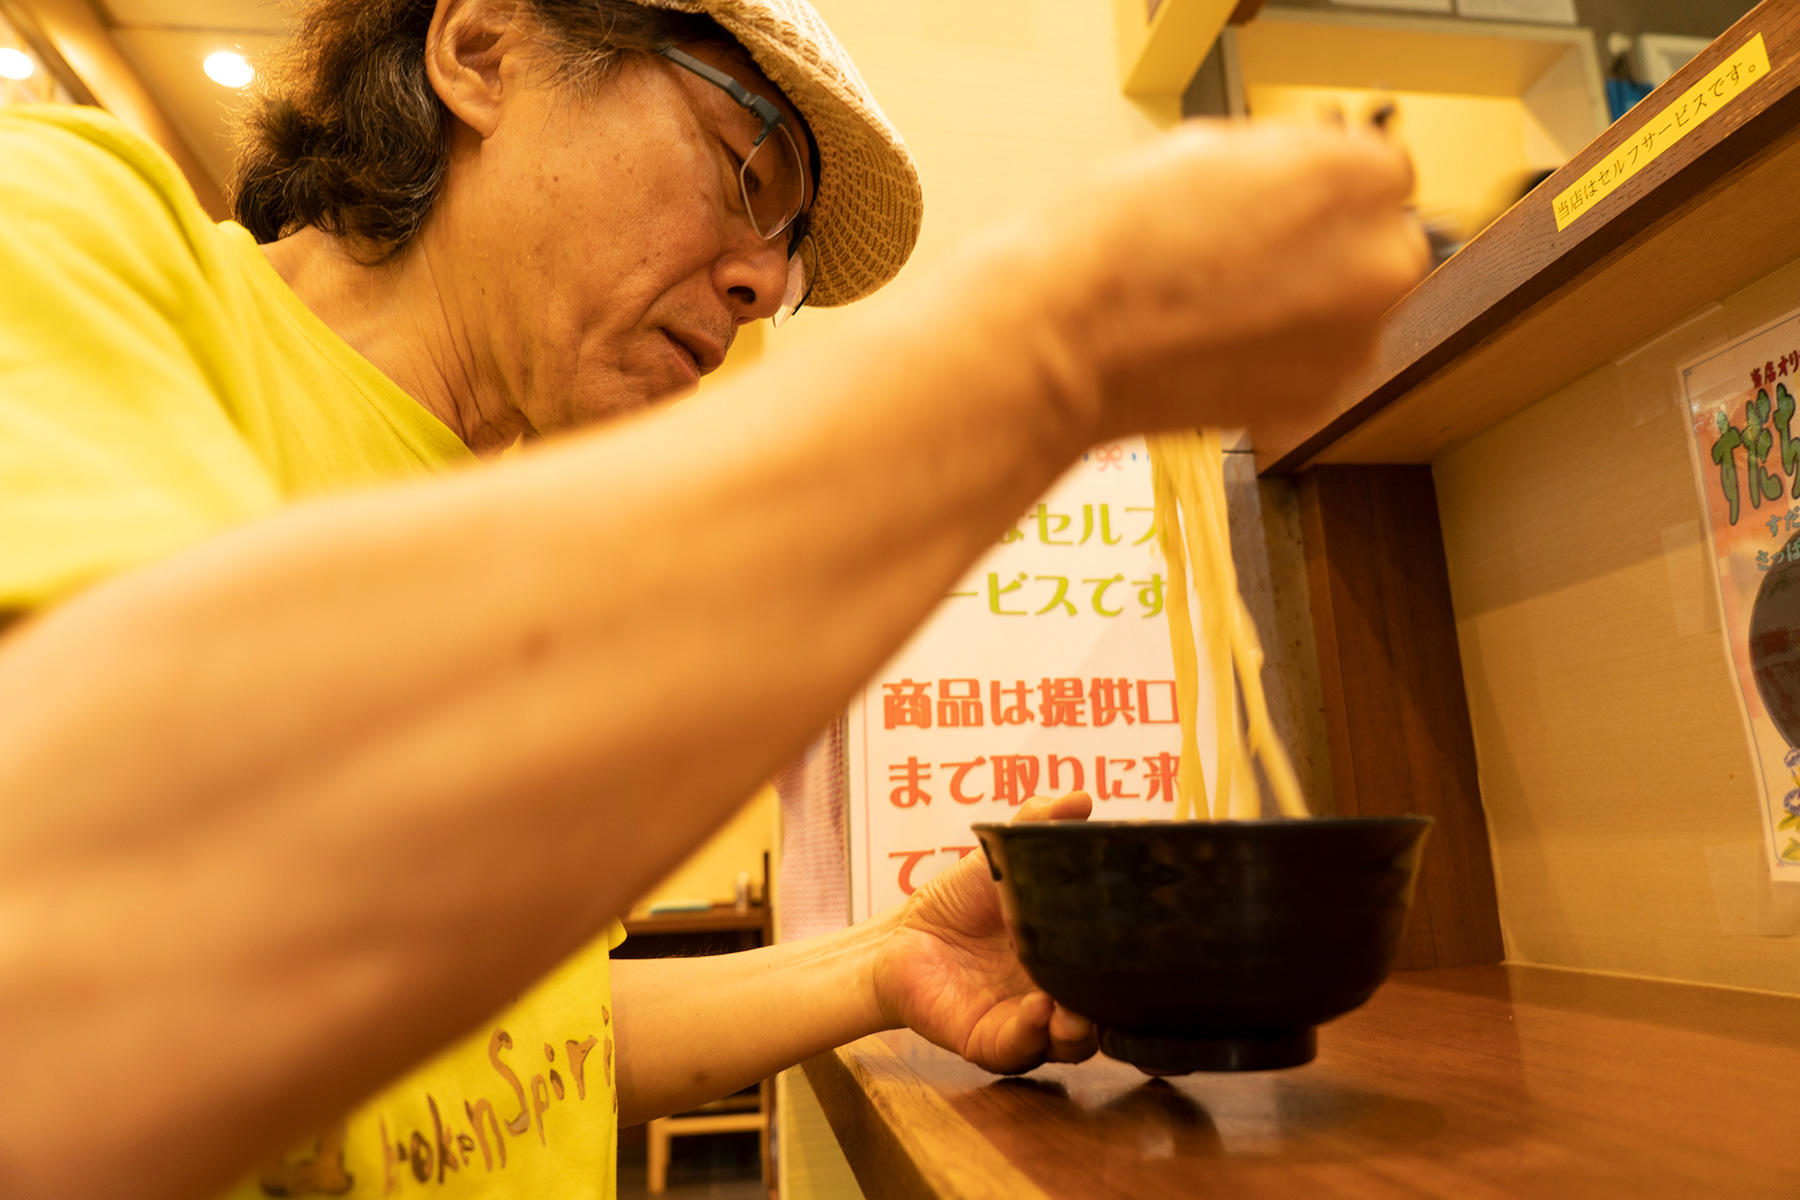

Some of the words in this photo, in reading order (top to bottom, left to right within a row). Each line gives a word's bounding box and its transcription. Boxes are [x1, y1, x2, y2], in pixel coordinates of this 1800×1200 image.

[1557, 62, 1756, 221] 当店はセルフサービスです。
[1750, 350, 1800, 389] 当店オリ
[882, 677, 1181, 730] 商品は提供口
[889, 751, 1182, 809] まで取りに来
